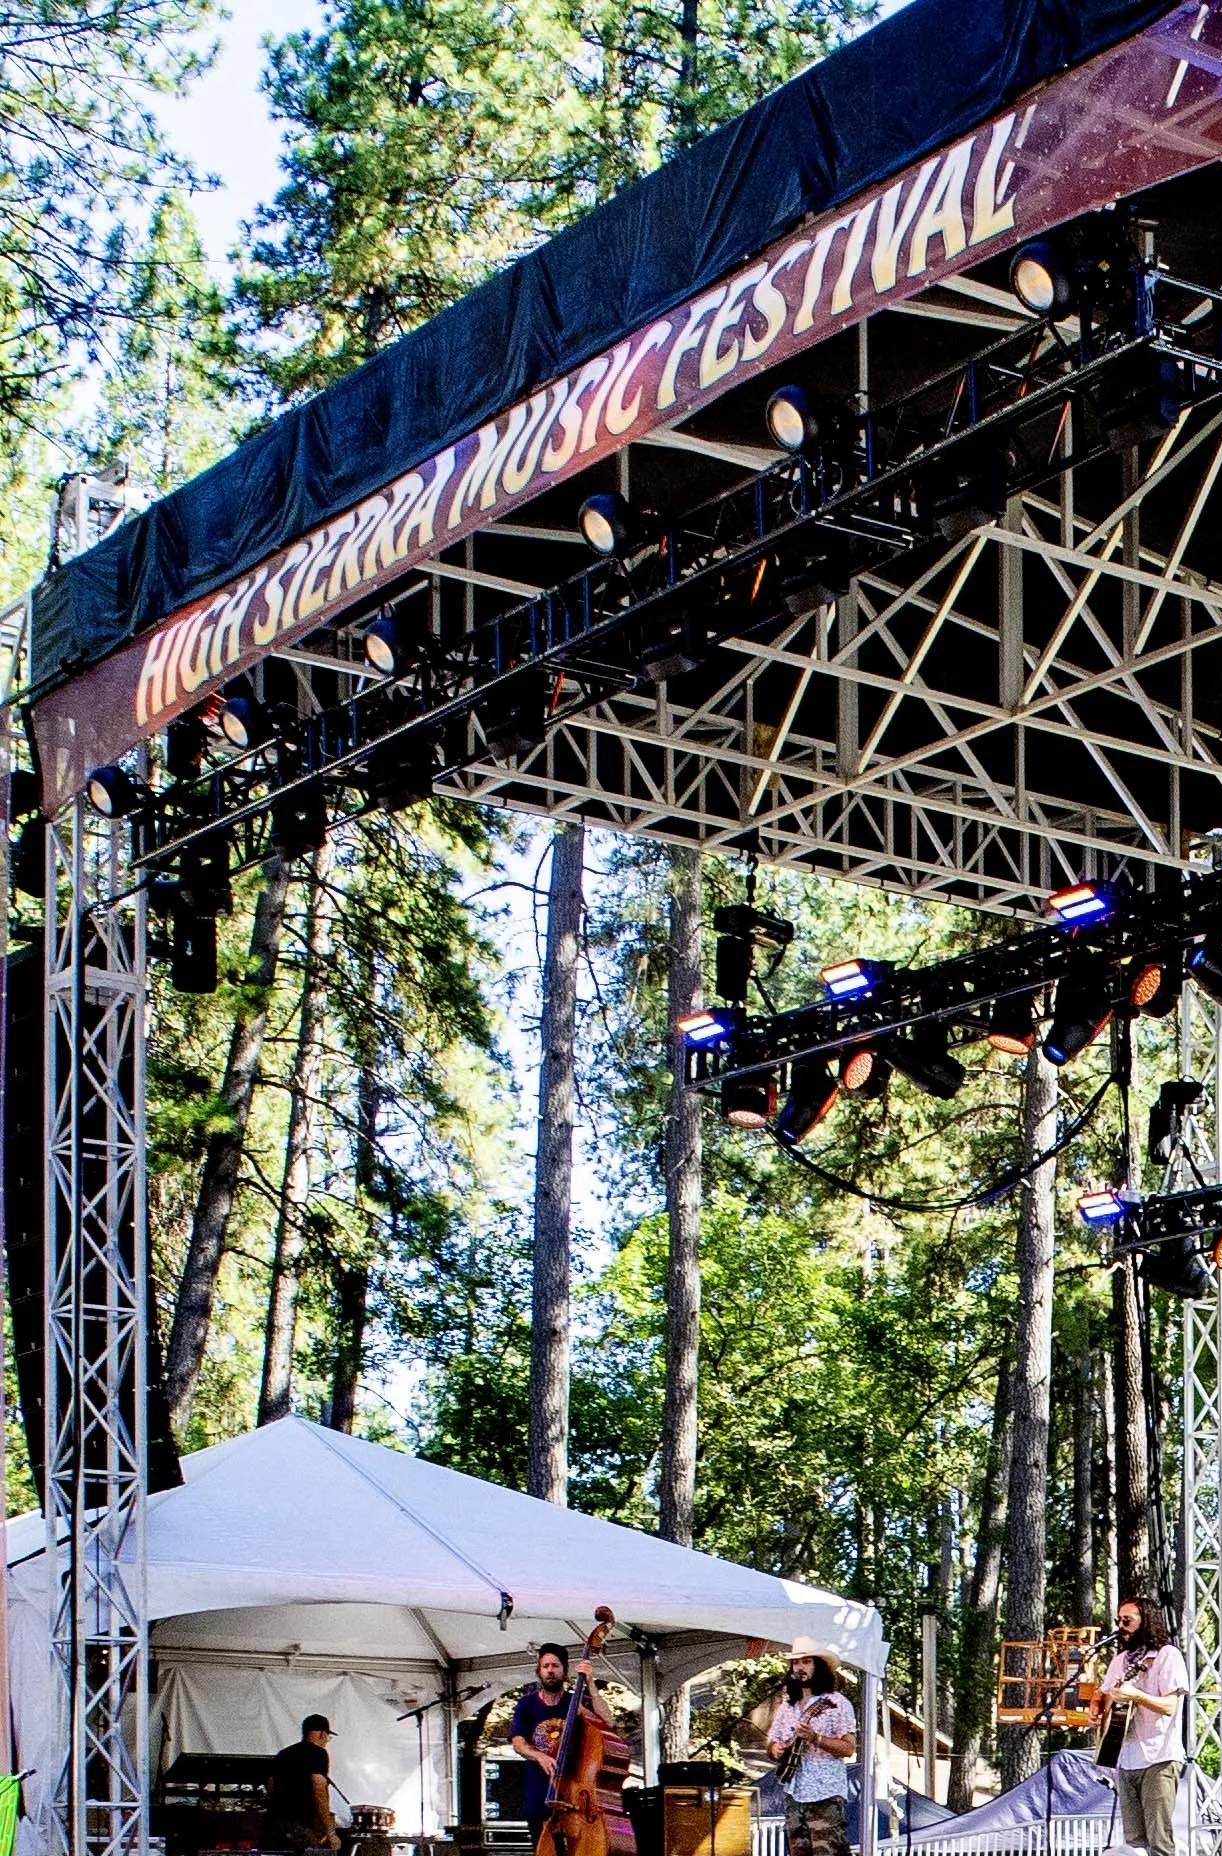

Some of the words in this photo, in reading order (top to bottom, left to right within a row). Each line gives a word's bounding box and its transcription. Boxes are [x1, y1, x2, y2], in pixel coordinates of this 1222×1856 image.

[136, 565, 270, 728] HIGH
[252, 444, 456, 646] SIERRA
[446, 319, 674, 530] MUSIC
[656, 112, 1018, 410] FESTIVAL
